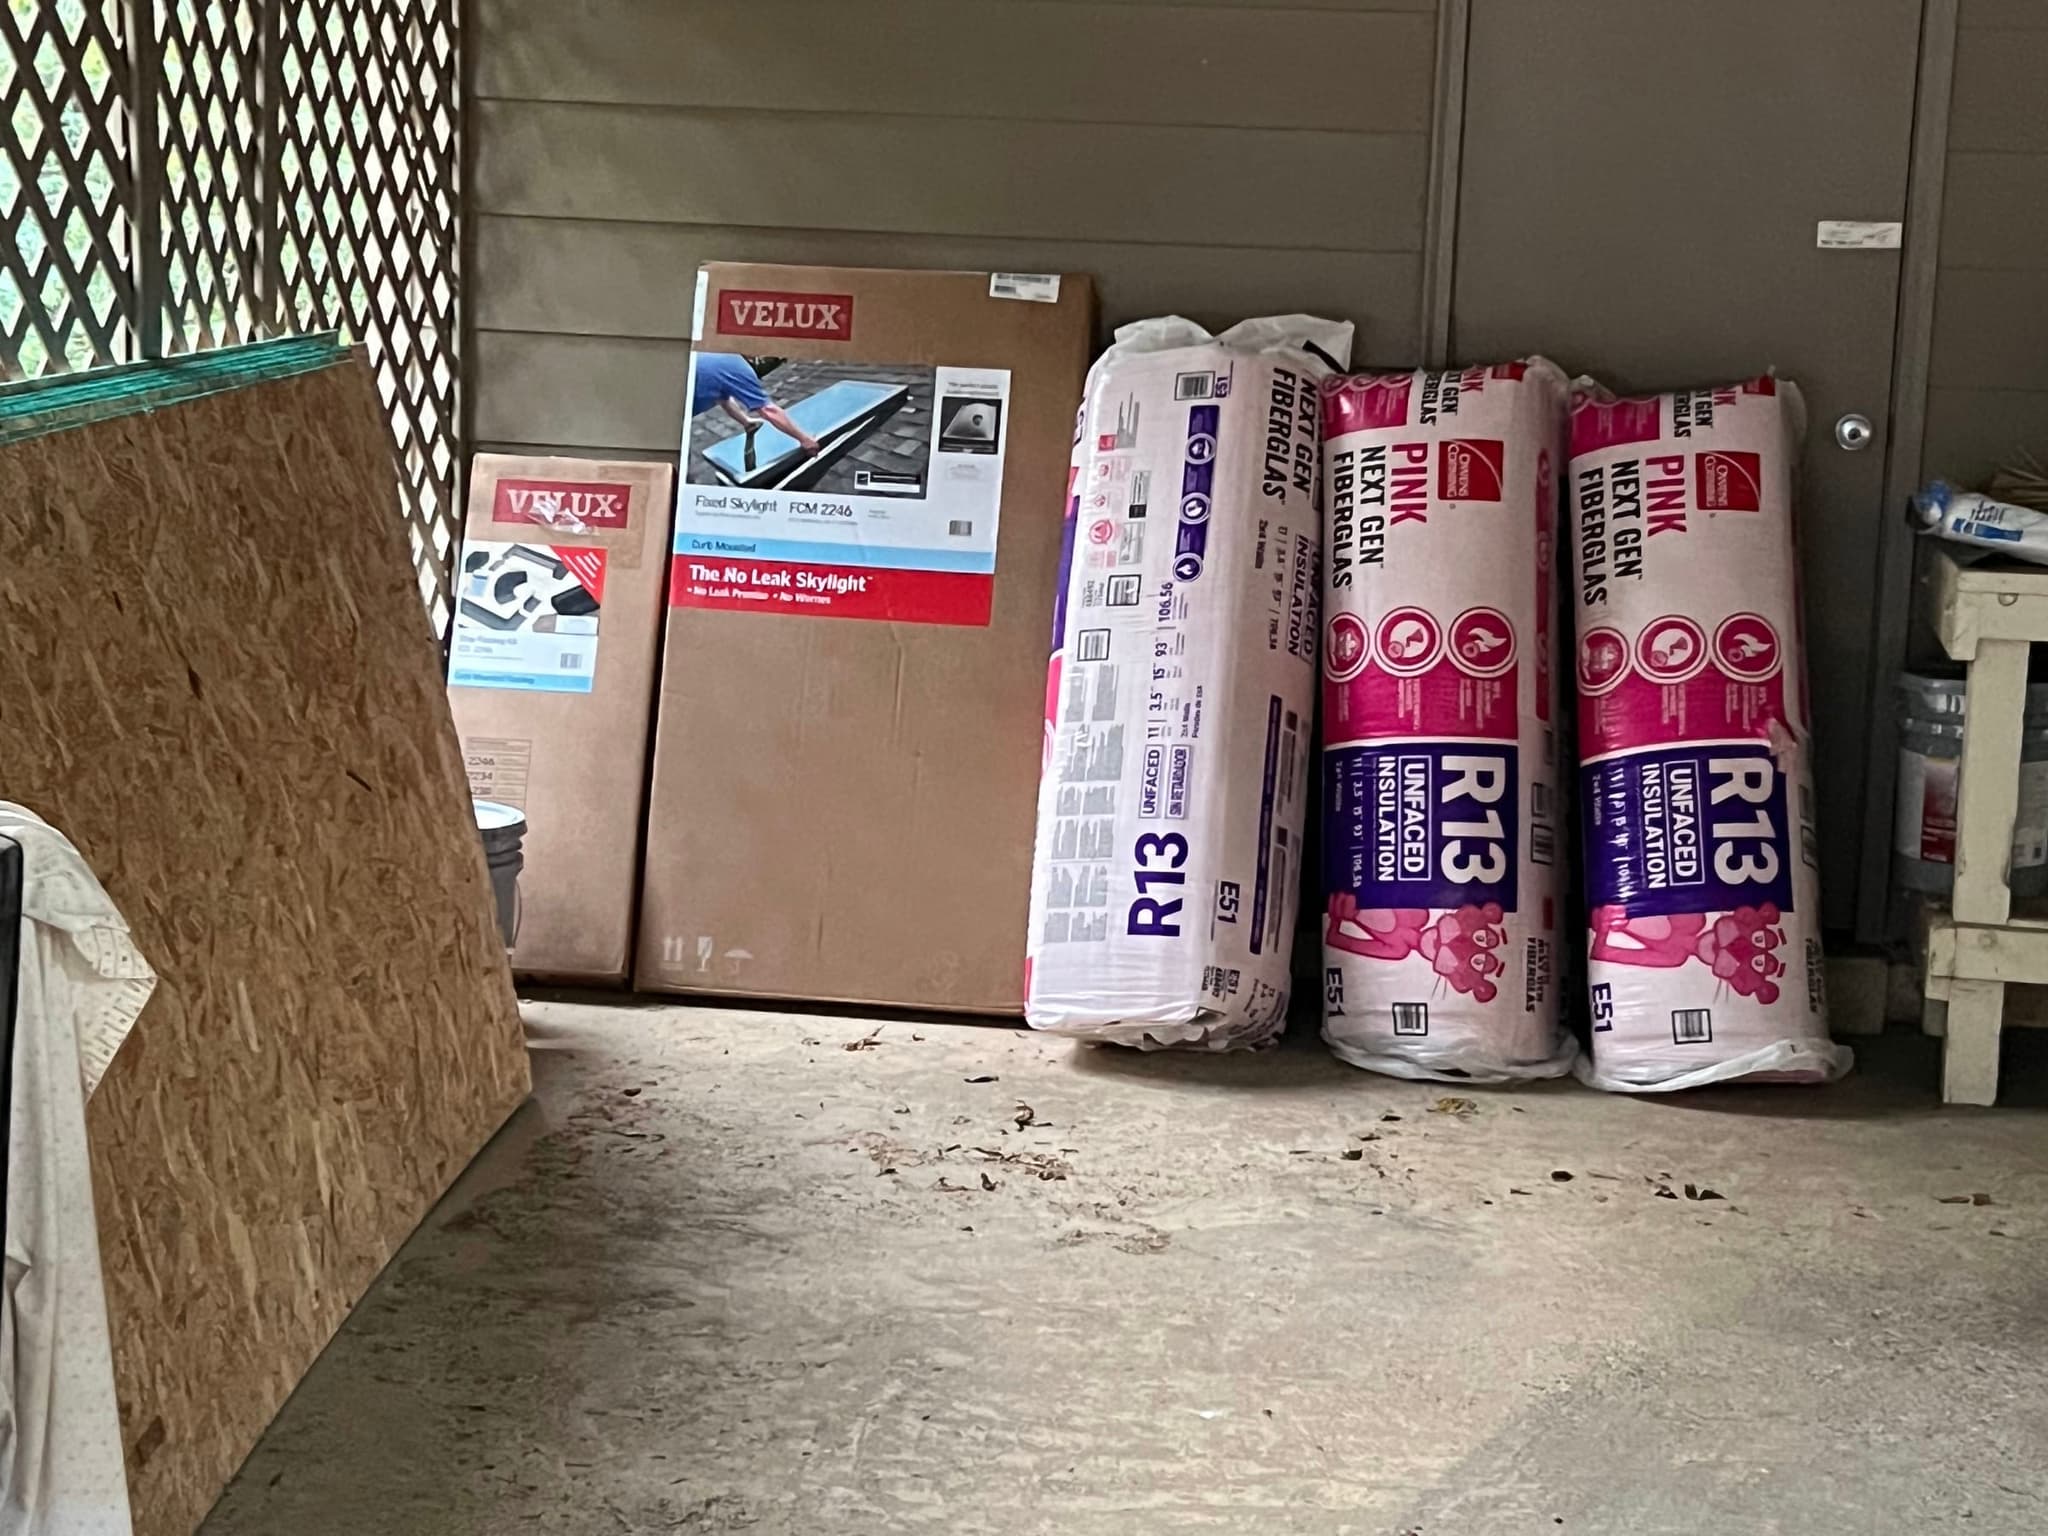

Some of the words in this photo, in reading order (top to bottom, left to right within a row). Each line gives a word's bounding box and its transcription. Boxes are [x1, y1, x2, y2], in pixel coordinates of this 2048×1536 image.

[730, 299, 841, 331] VELUX
[1298, 377, 1317, 437] NEXT
[507, 489, 618, 518] VELUX
[729, 497, 777, 512] Skylight
[789, 501, 817, 514] FCM
[821, 503, 853, 518] 2246
[1360, 445, 1386, 506] NEXT
[1390, 443, 1428, 526] PINK
[1611, 458, 1640, 520] NEXT
[1645, 454, 1687, 537] PINK
[689, 564, 720, 582] The
[725, 567, 747, 584] No
[751, 569, 791, 587] Leak
[1288, 535, 1309, 656] INSULATION
[1142, 749, 1160, 814] UNFACED
[1378, 756, 1396, 882] INSULATION
[1404, 763, 1426, 873] UNFACED
[1441, 755, 1506, 885] R13
[1641, 762, 1667, 889] INSULATION
[1669, 767, 1696, 877] UNFACED
[1708, 757, 1779, 885] R13
[1127, 832, 1189, 937] R13
[1217, 880, 1241, 924] E51
[1326, 967, 1345, 1018] E51
[1591, 982, 1614, 1032] E51
